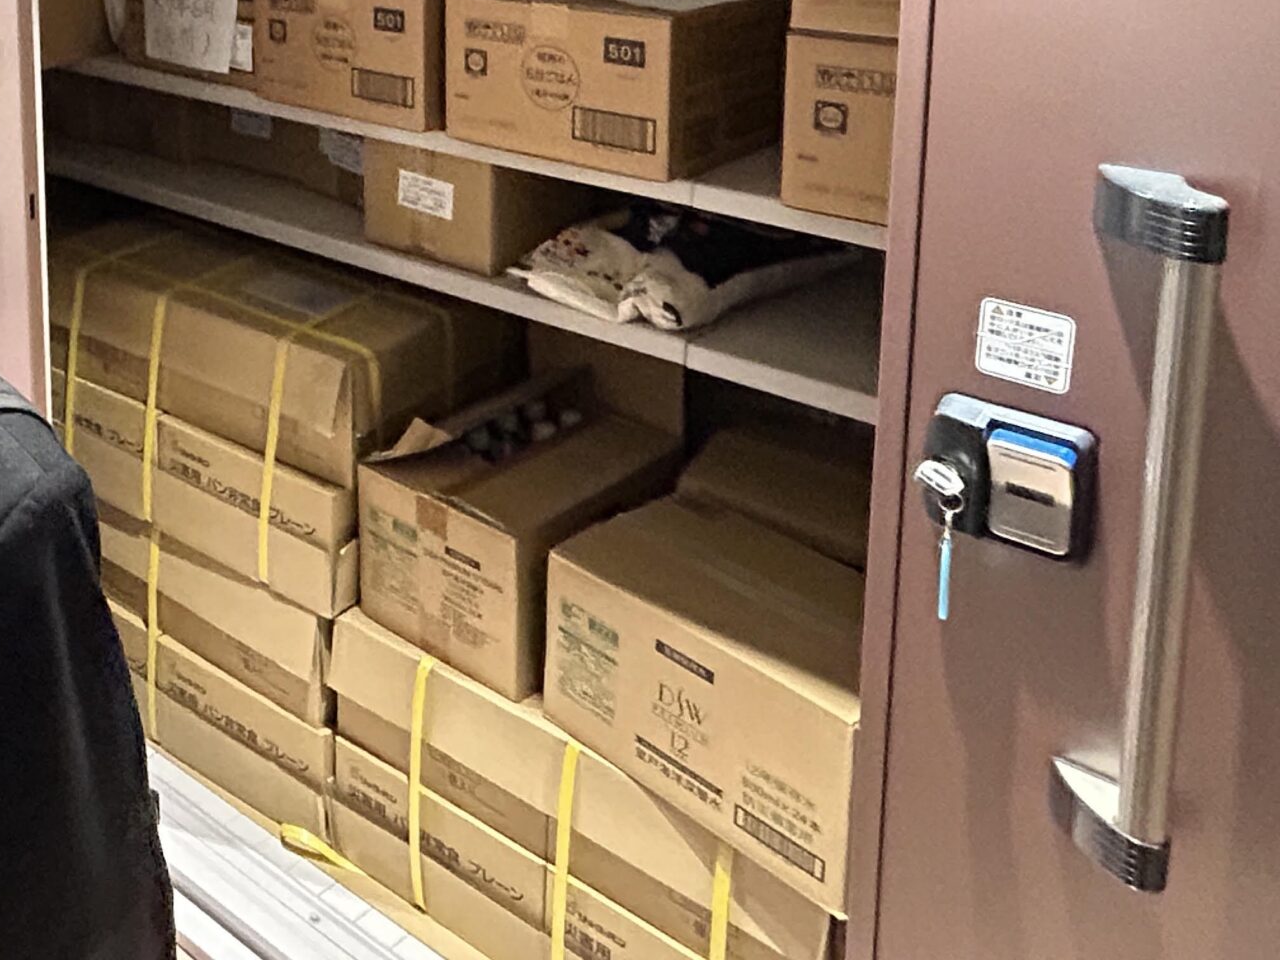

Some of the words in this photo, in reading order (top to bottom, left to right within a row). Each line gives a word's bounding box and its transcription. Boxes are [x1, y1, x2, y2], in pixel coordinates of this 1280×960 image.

[376, 12, 403, 29] 501
[608, 41, 642, 61] 501
[268, 506, 316, 536] プレーン
[264, 738, 310, 772] プレーン
[468, 859, 524, 901] プレーン
